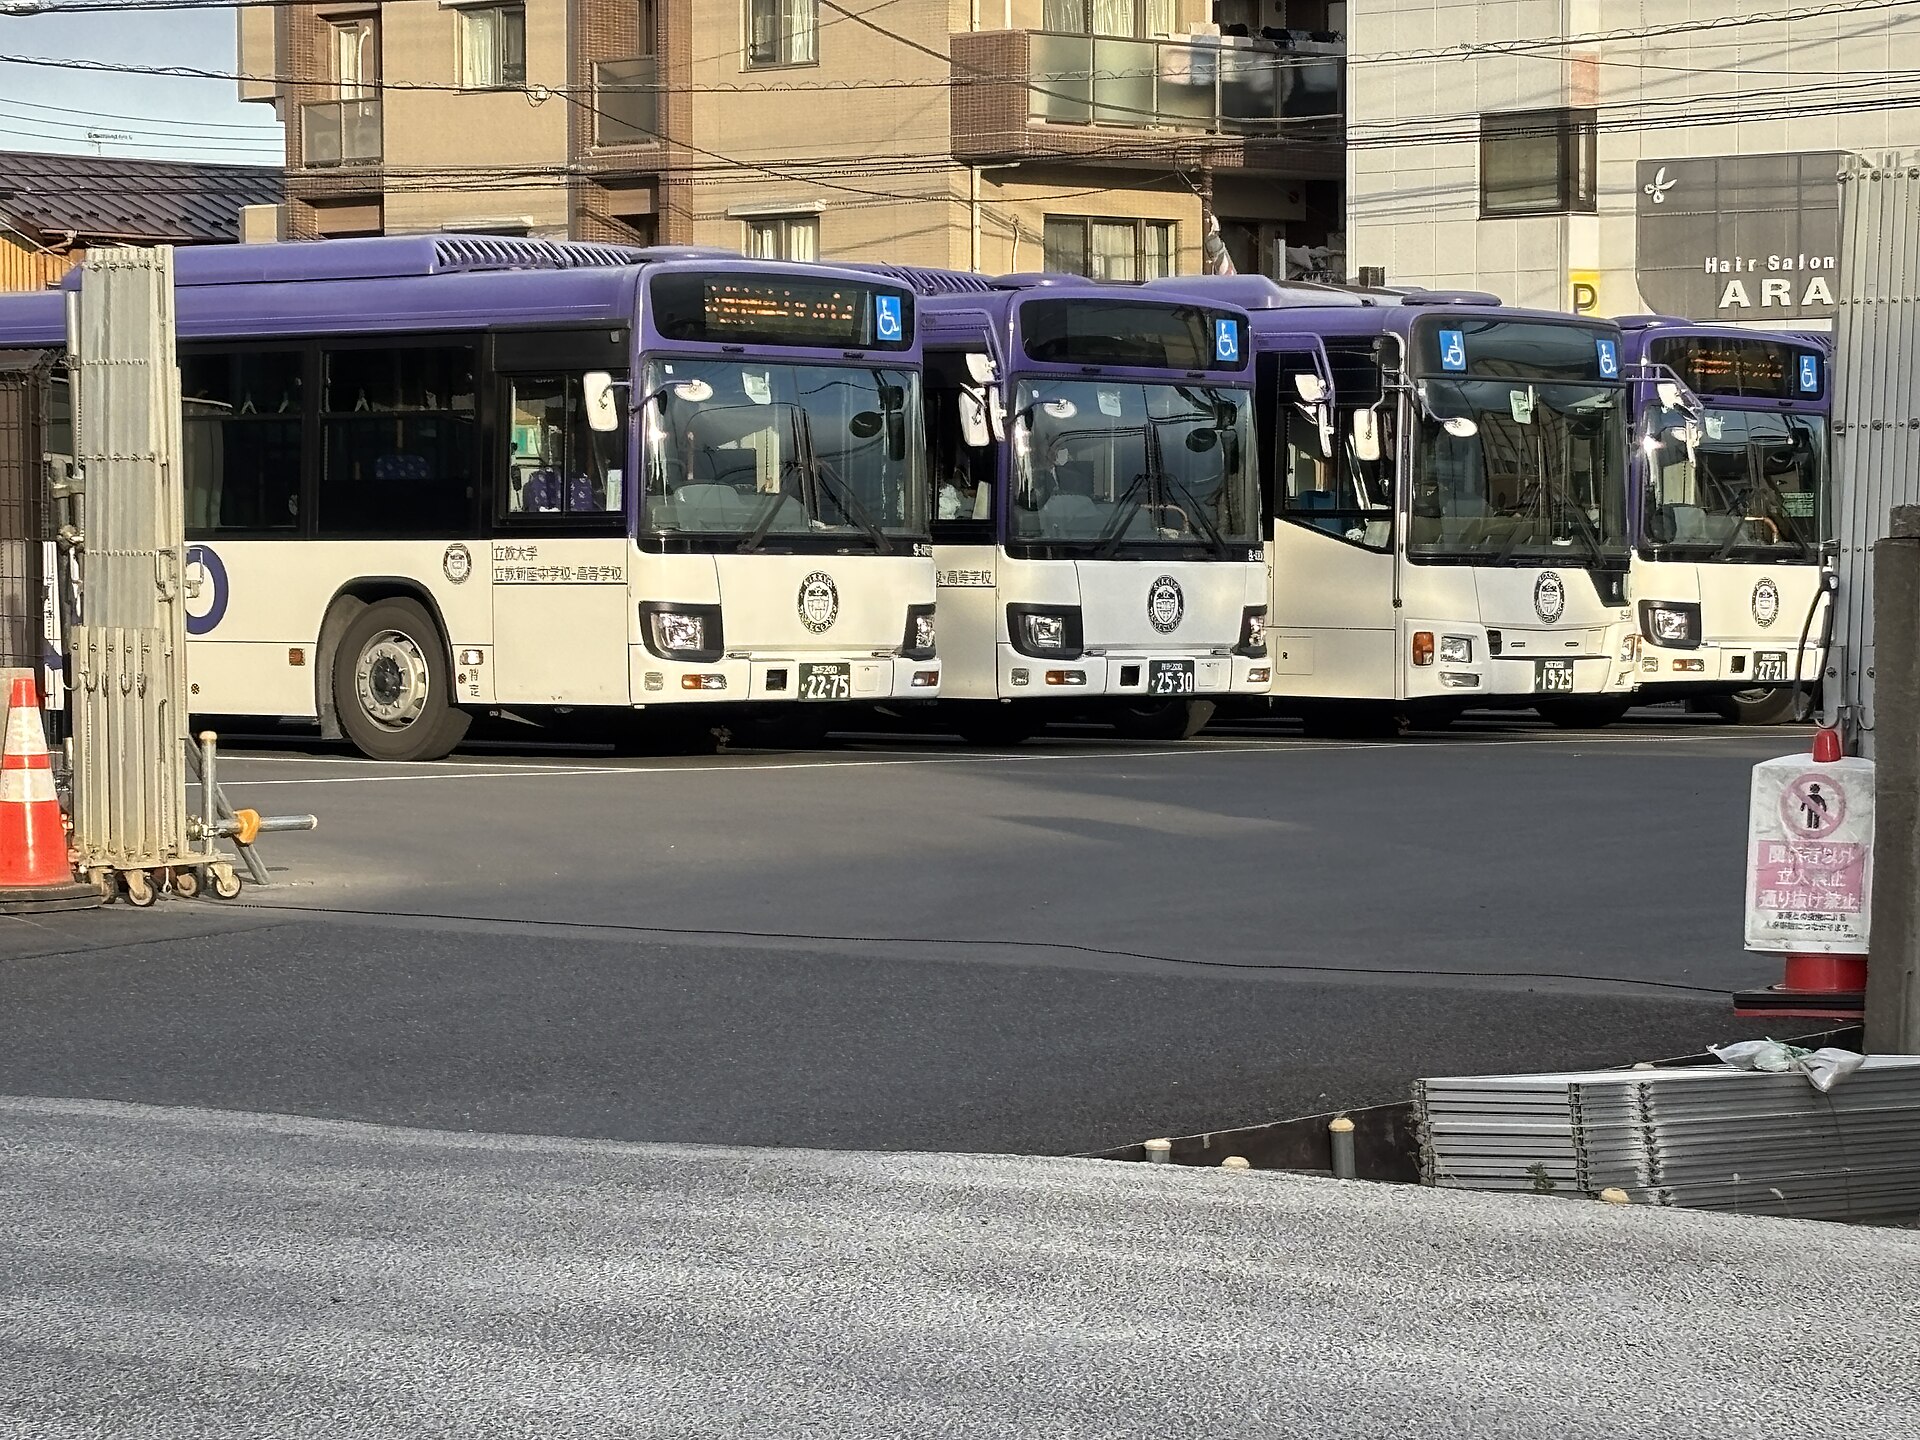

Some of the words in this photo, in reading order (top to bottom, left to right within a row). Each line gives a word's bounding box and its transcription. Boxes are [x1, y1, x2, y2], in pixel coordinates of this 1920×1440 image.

[1704, 256, 1757, 274] Hair
[1767, 254, 1835, 272] Salon
[1572, 283, 1598, 313] P
[1718, 276, 1835, 309] ARA
